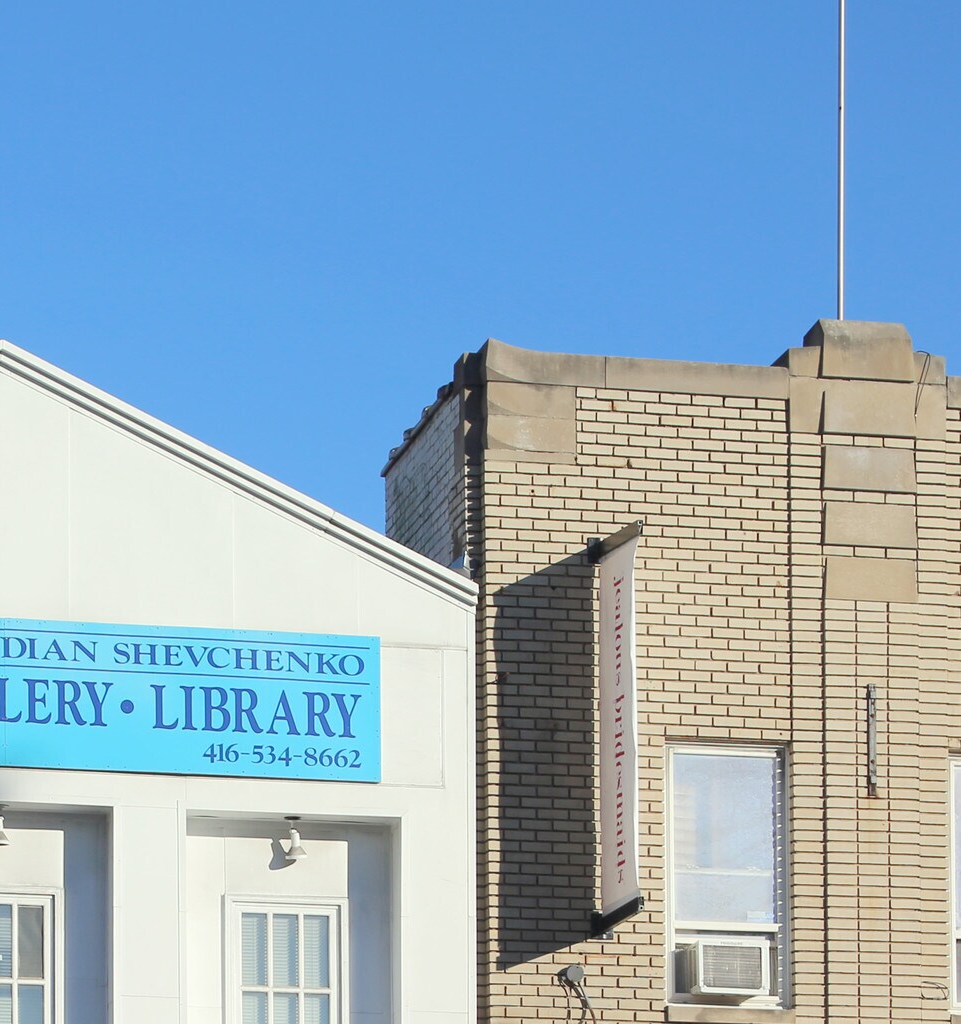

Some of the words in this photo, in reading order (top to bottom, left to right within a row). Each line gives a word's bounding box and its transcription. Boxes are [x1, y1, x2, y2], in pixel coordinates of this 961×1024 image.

[113, 642, 365, 676] SHEVCHENKO
[150, 684, 362, 739] LIBRARY
[202, 743, 362, 769] 416-534-8662
